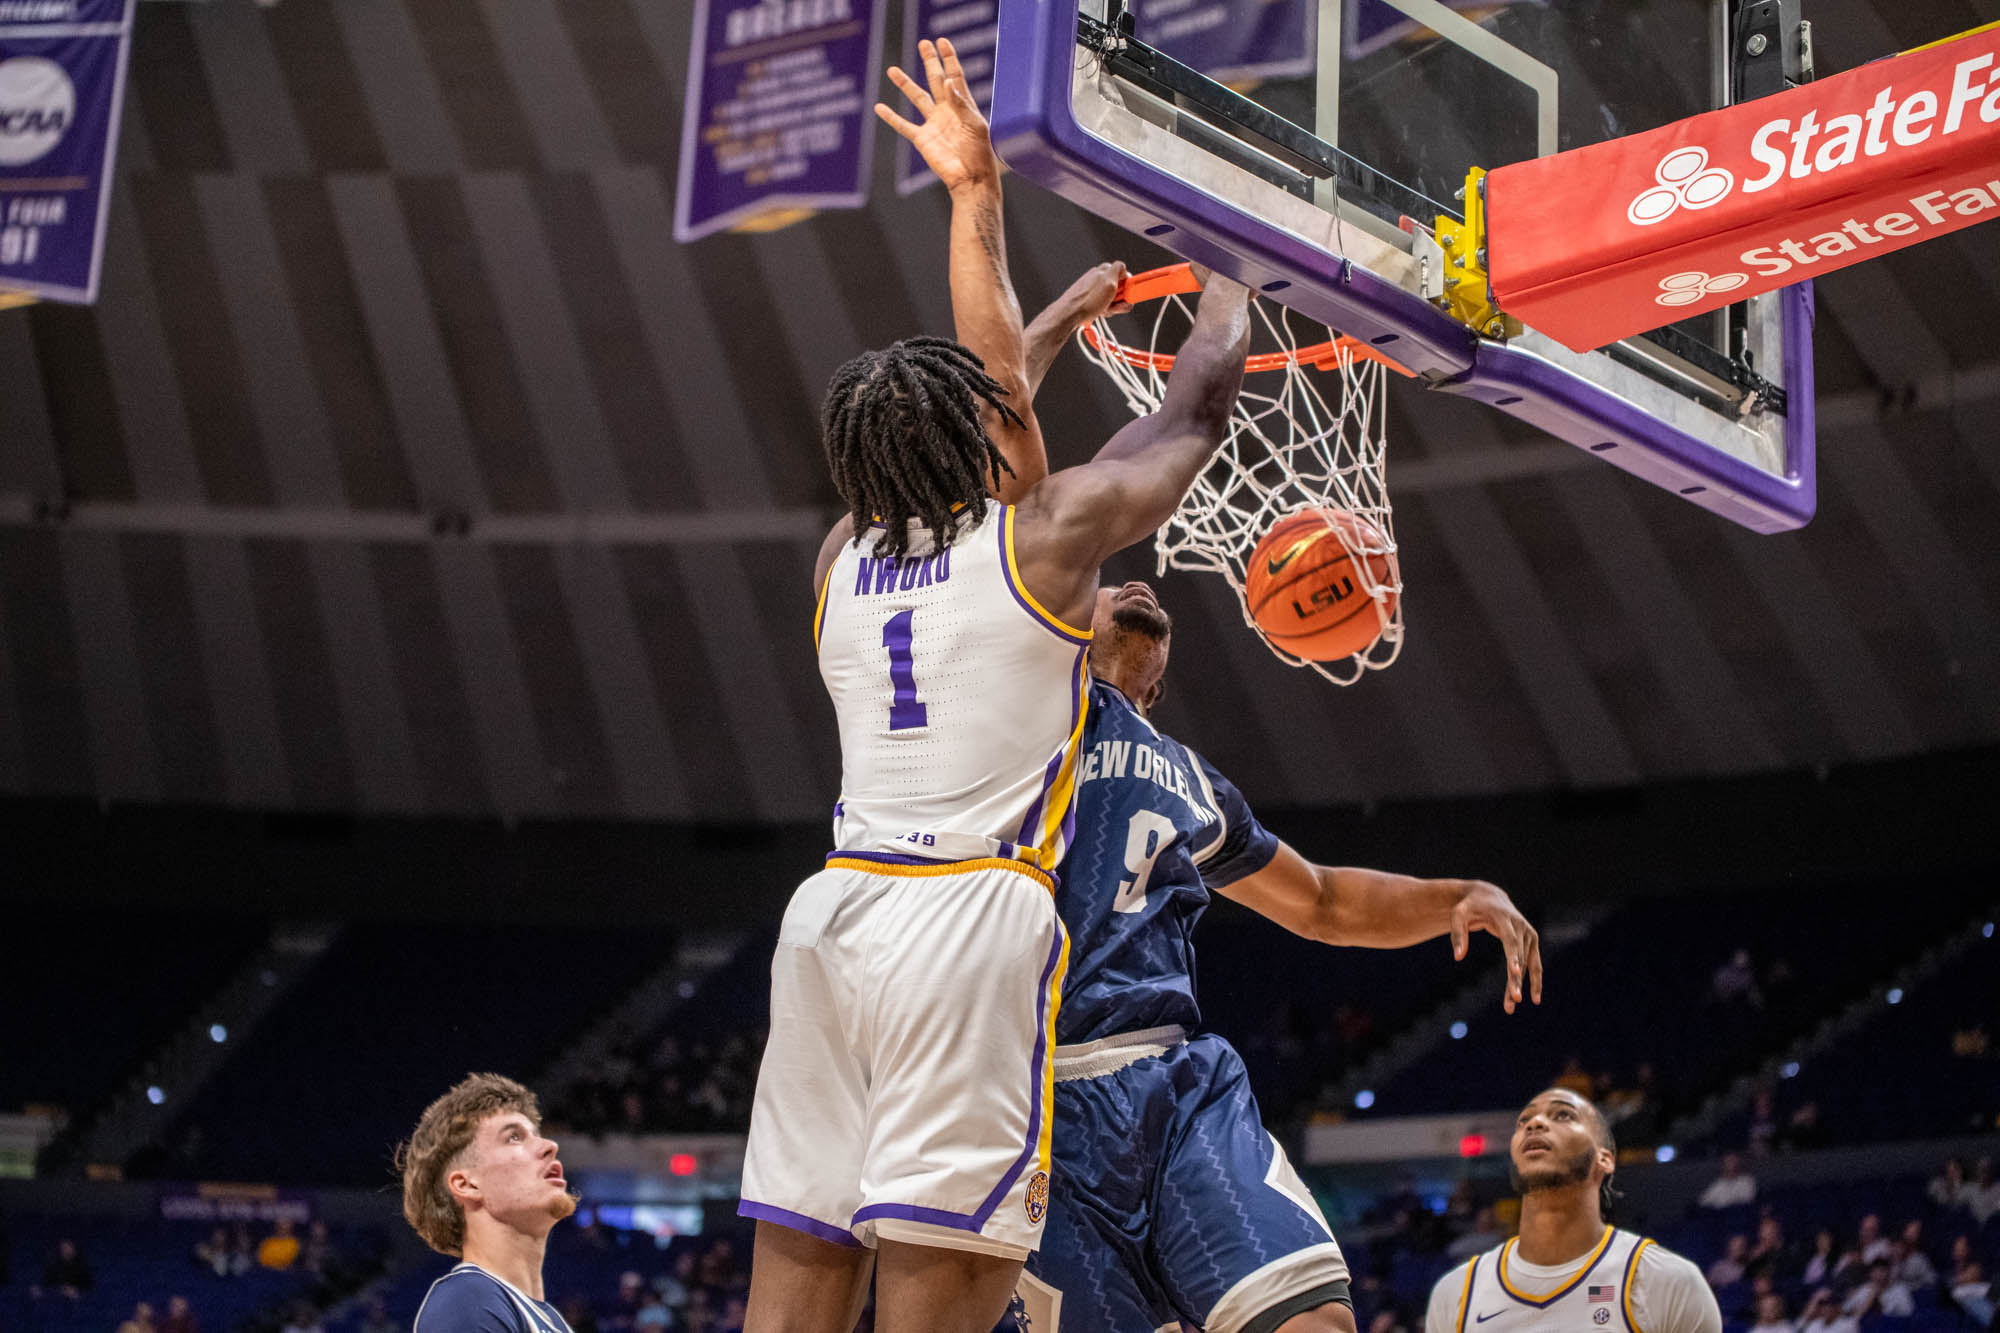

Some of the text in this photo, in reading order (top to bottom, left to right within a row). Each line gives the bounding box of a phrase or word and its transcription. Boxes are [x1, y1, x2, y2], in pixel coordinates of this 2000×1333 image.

[1742, 86, 1938, 193] State
[1740, 212, 1920, 276] State
[1293, 576, 1354, 619] LSU
[883, 609, 928, 731] 1
[1113, 809, 1178, 914] 9
